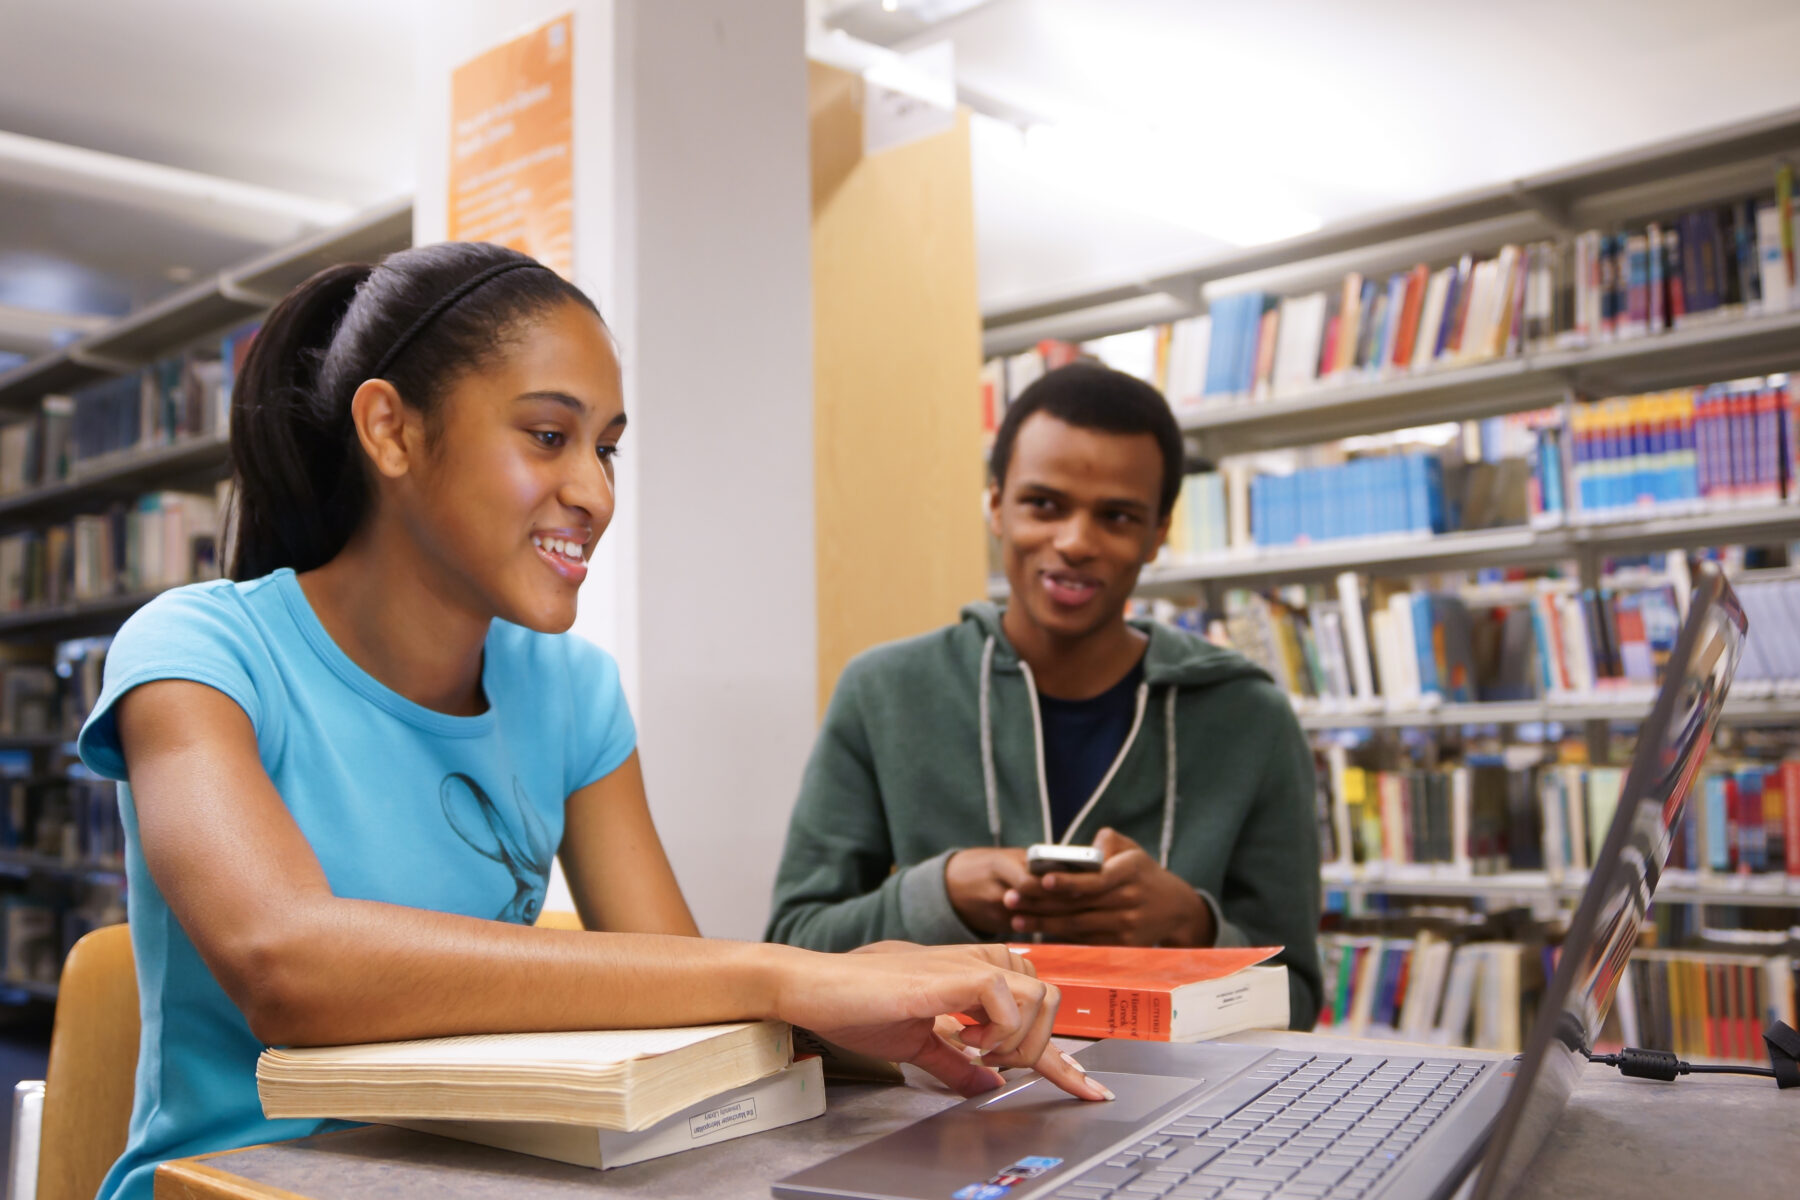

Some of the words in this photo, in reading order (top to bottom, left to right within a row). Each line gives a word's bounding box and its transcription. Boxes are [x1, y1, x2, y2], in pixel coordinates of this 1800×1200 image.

[1107, 989, 1117, 1034] Philosophy
[1120, 1000, 1128, 1026] Greek
[1130, 993, 1139, 1025] History
[1131, 1028, 1139, 1037] of
[694, 1119, 720, 1134] Metropolitan
